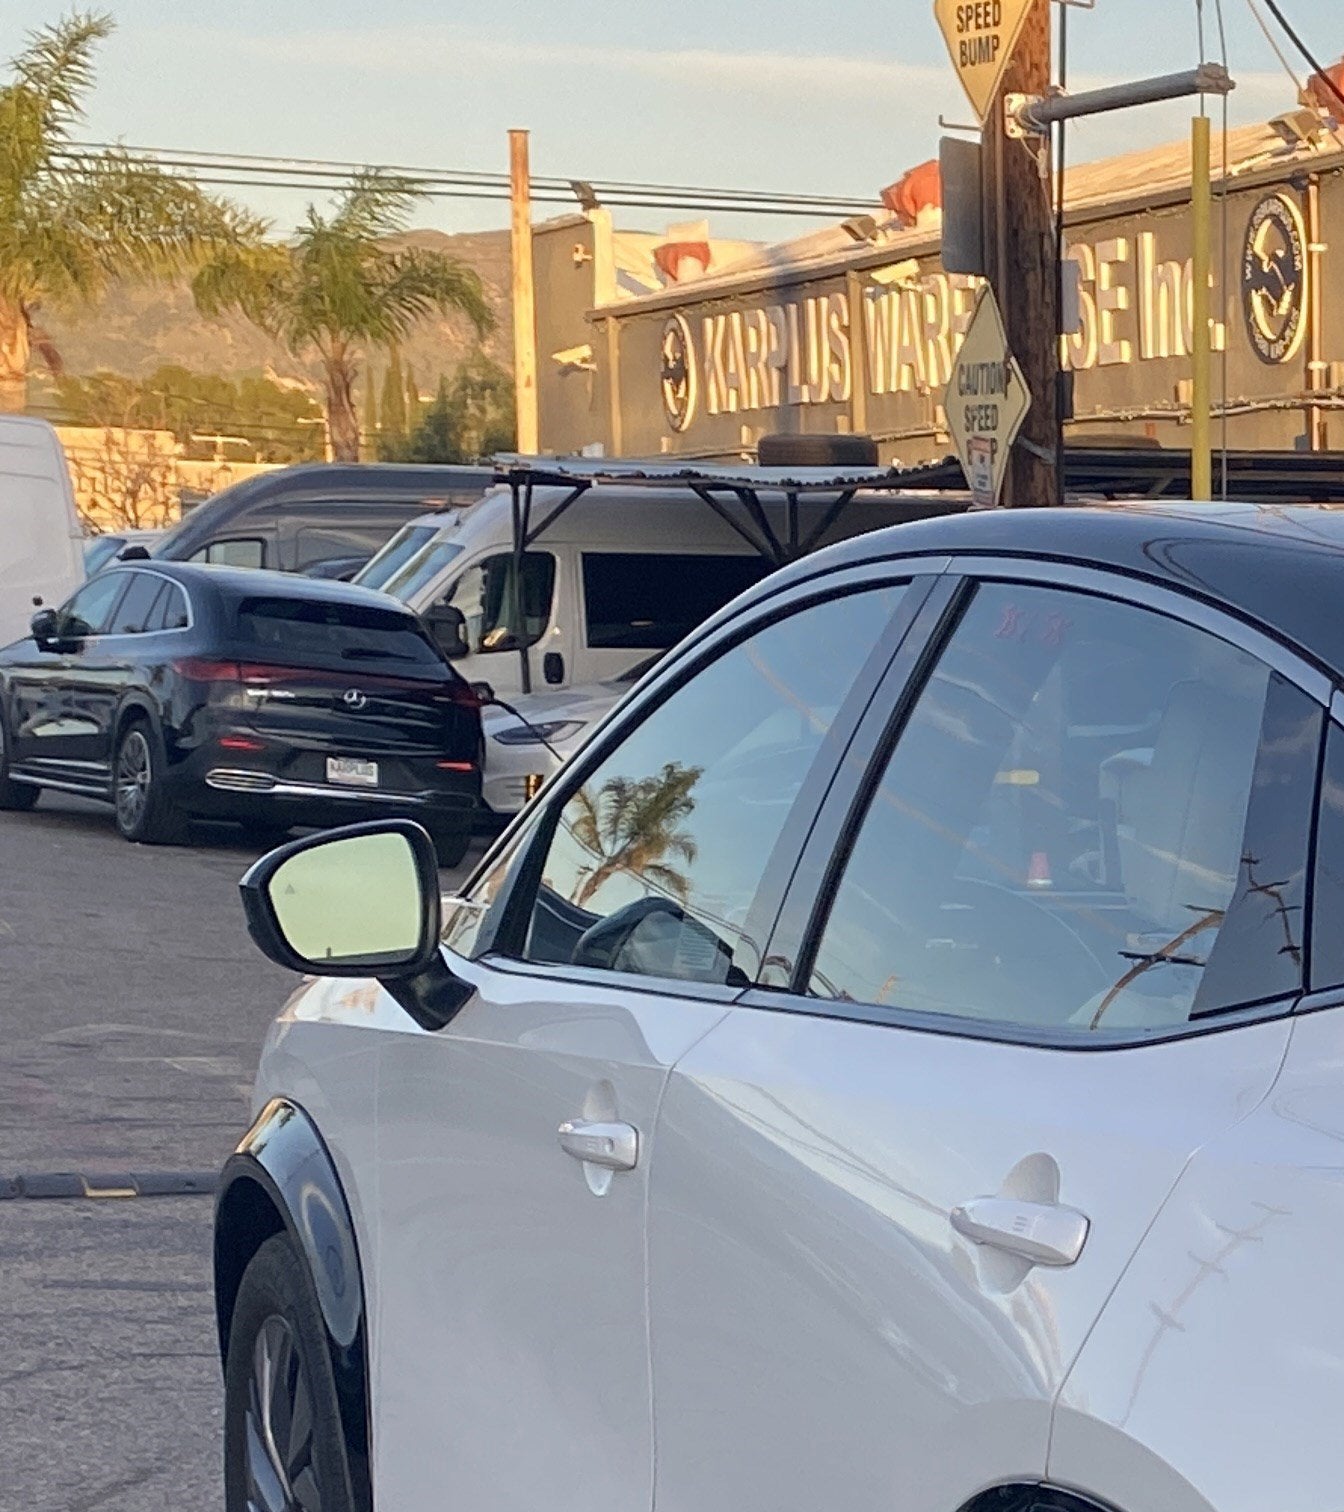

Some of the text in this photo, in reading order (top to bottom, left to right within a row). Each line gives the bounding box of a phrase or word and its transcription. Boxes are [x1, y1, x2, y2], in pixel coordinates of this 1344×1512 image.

[957, 0, 1001, 33] SPEED
[959, 34, 1000, 67] BUMP
[958, 362, 1005, 397] CAUTION
[965, 404, 998, 432] SPEED
